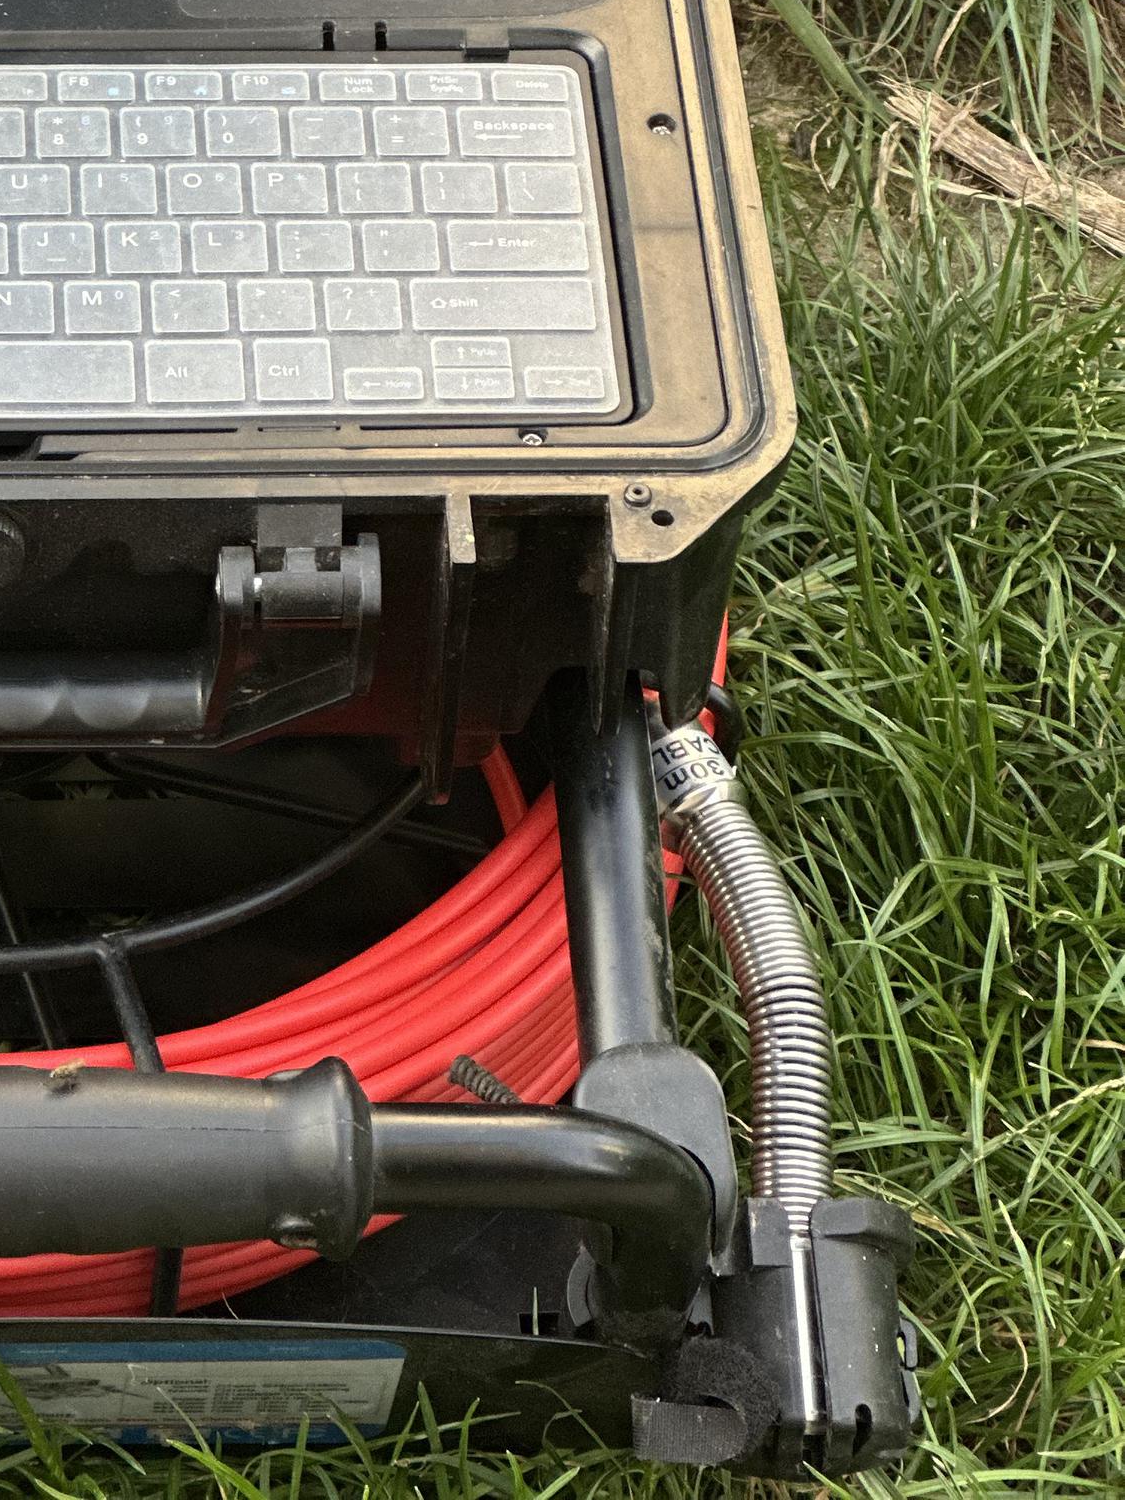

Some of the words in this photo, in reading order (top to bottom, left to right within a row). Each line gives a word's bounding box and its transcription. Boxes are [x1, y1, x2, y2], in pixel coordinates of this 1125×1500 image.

[156, 76, 176, 86] F9
[242, 75, 269, 86] F10
[344, 77, 373, 86] Num
[344, 85, 375, 94] Lock
[473, 120, 556, 132] Backspace
[53, 133, 64, 145] 8
[137, 132, 148, 145] 9
[11, 175, 28, 189] U
[182, 173, 202, 188] O
[268, 173, 284, 188] P
[36, 232, 49, 247] J
[122, 232, 139, 246] K
[208, 232, 222, 246] L
[497, 237, 536, 248] Enter
[82, 291, 102, 305] M
[165, 366, 189, 378] Alt
[268, 364, 301, 377] Ctrl
[663, 759, 725, 791] 30m
